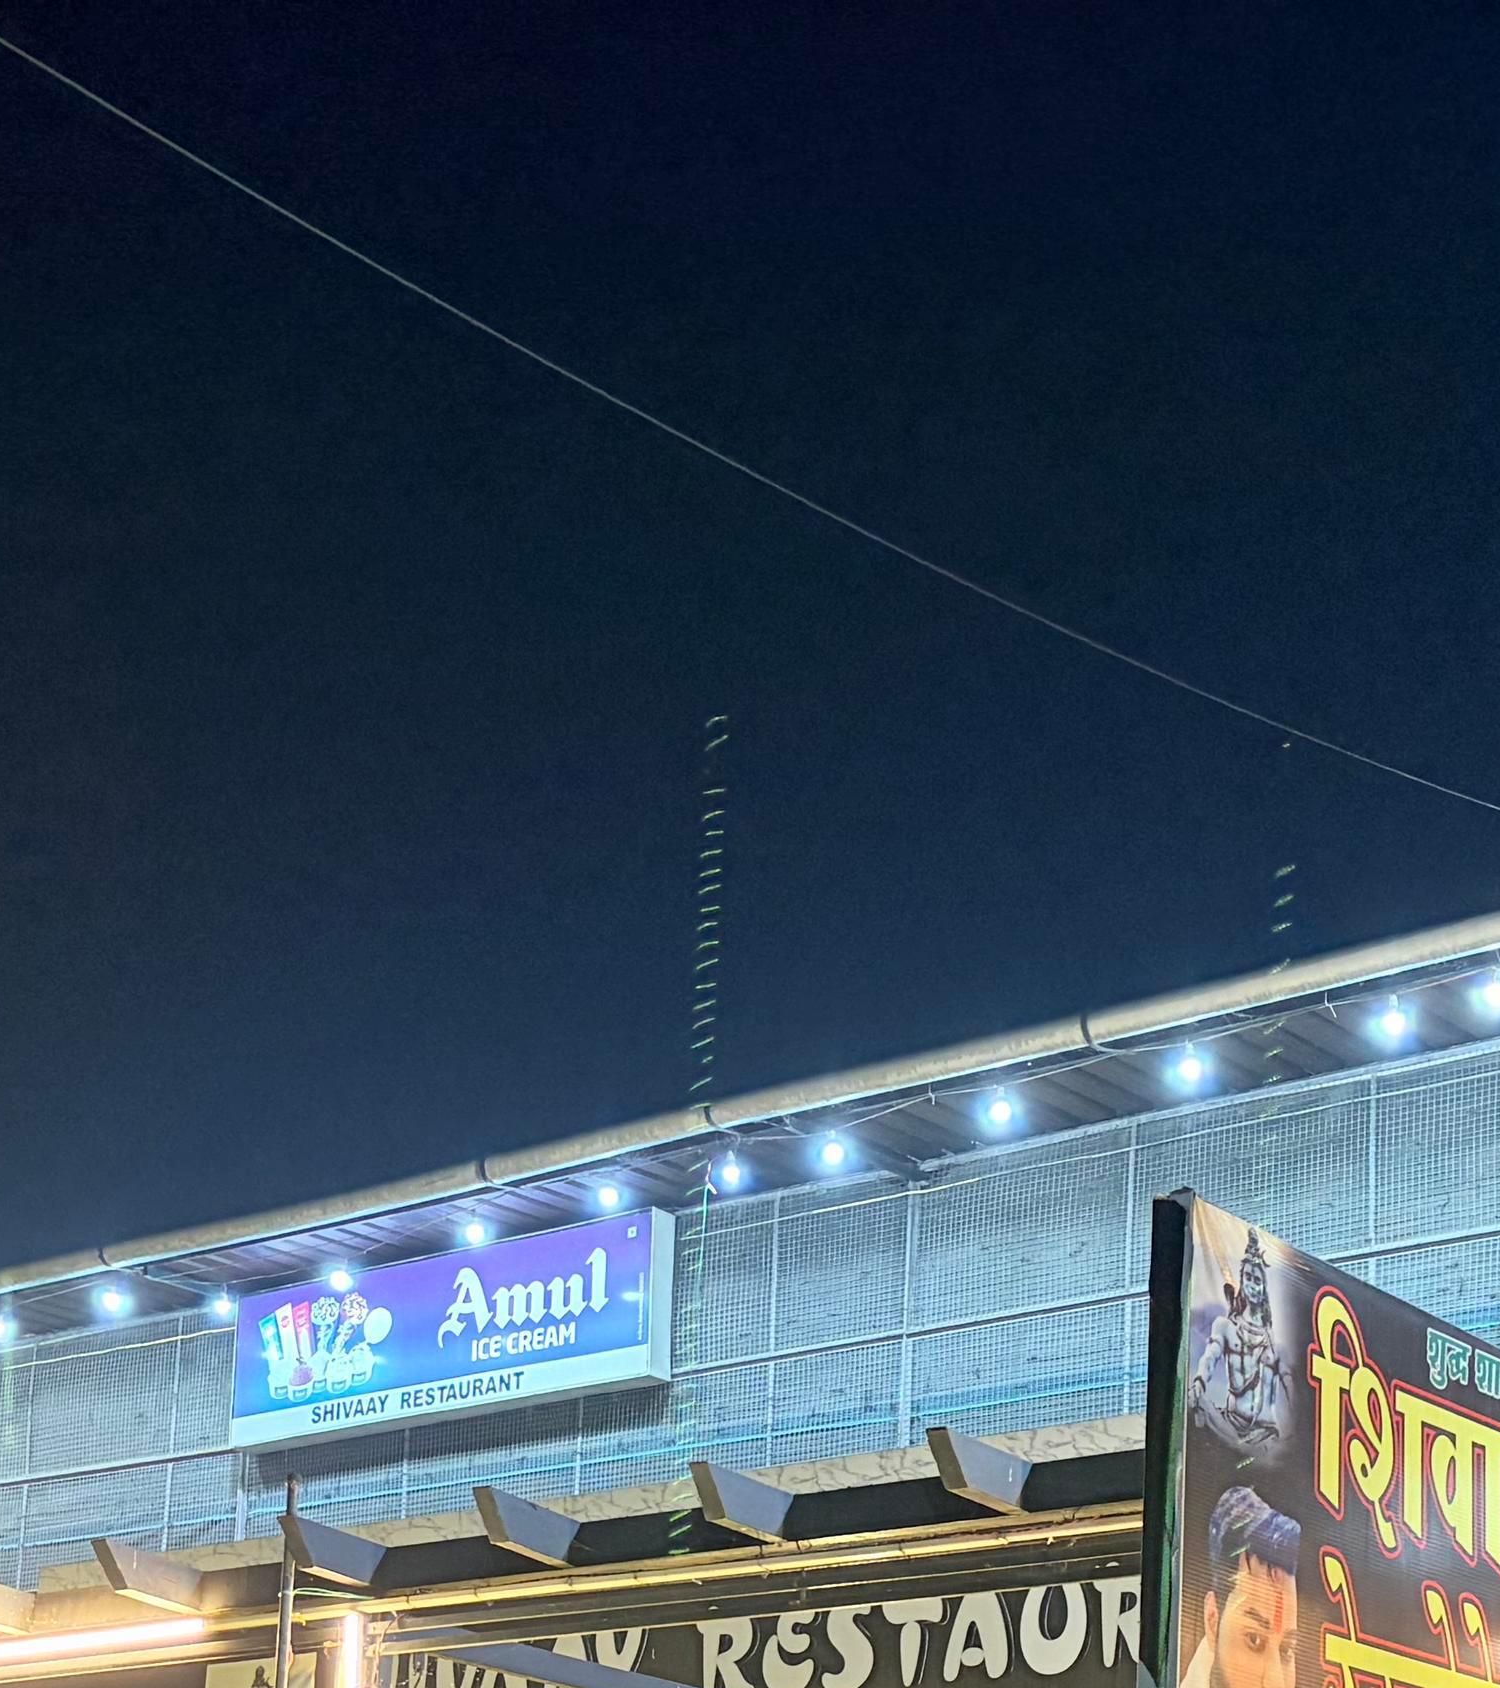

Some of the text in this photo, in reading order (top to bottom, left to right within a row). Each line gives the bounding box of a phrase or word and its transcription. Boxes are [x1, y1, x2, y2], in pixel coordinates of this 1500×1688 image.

[438, 1247, 610, 1348] Amul
[471, 1321, 576, 1362] ICE CREAM
[311, 1371, 525, 1424] SHIVAAY RESTAURANT
